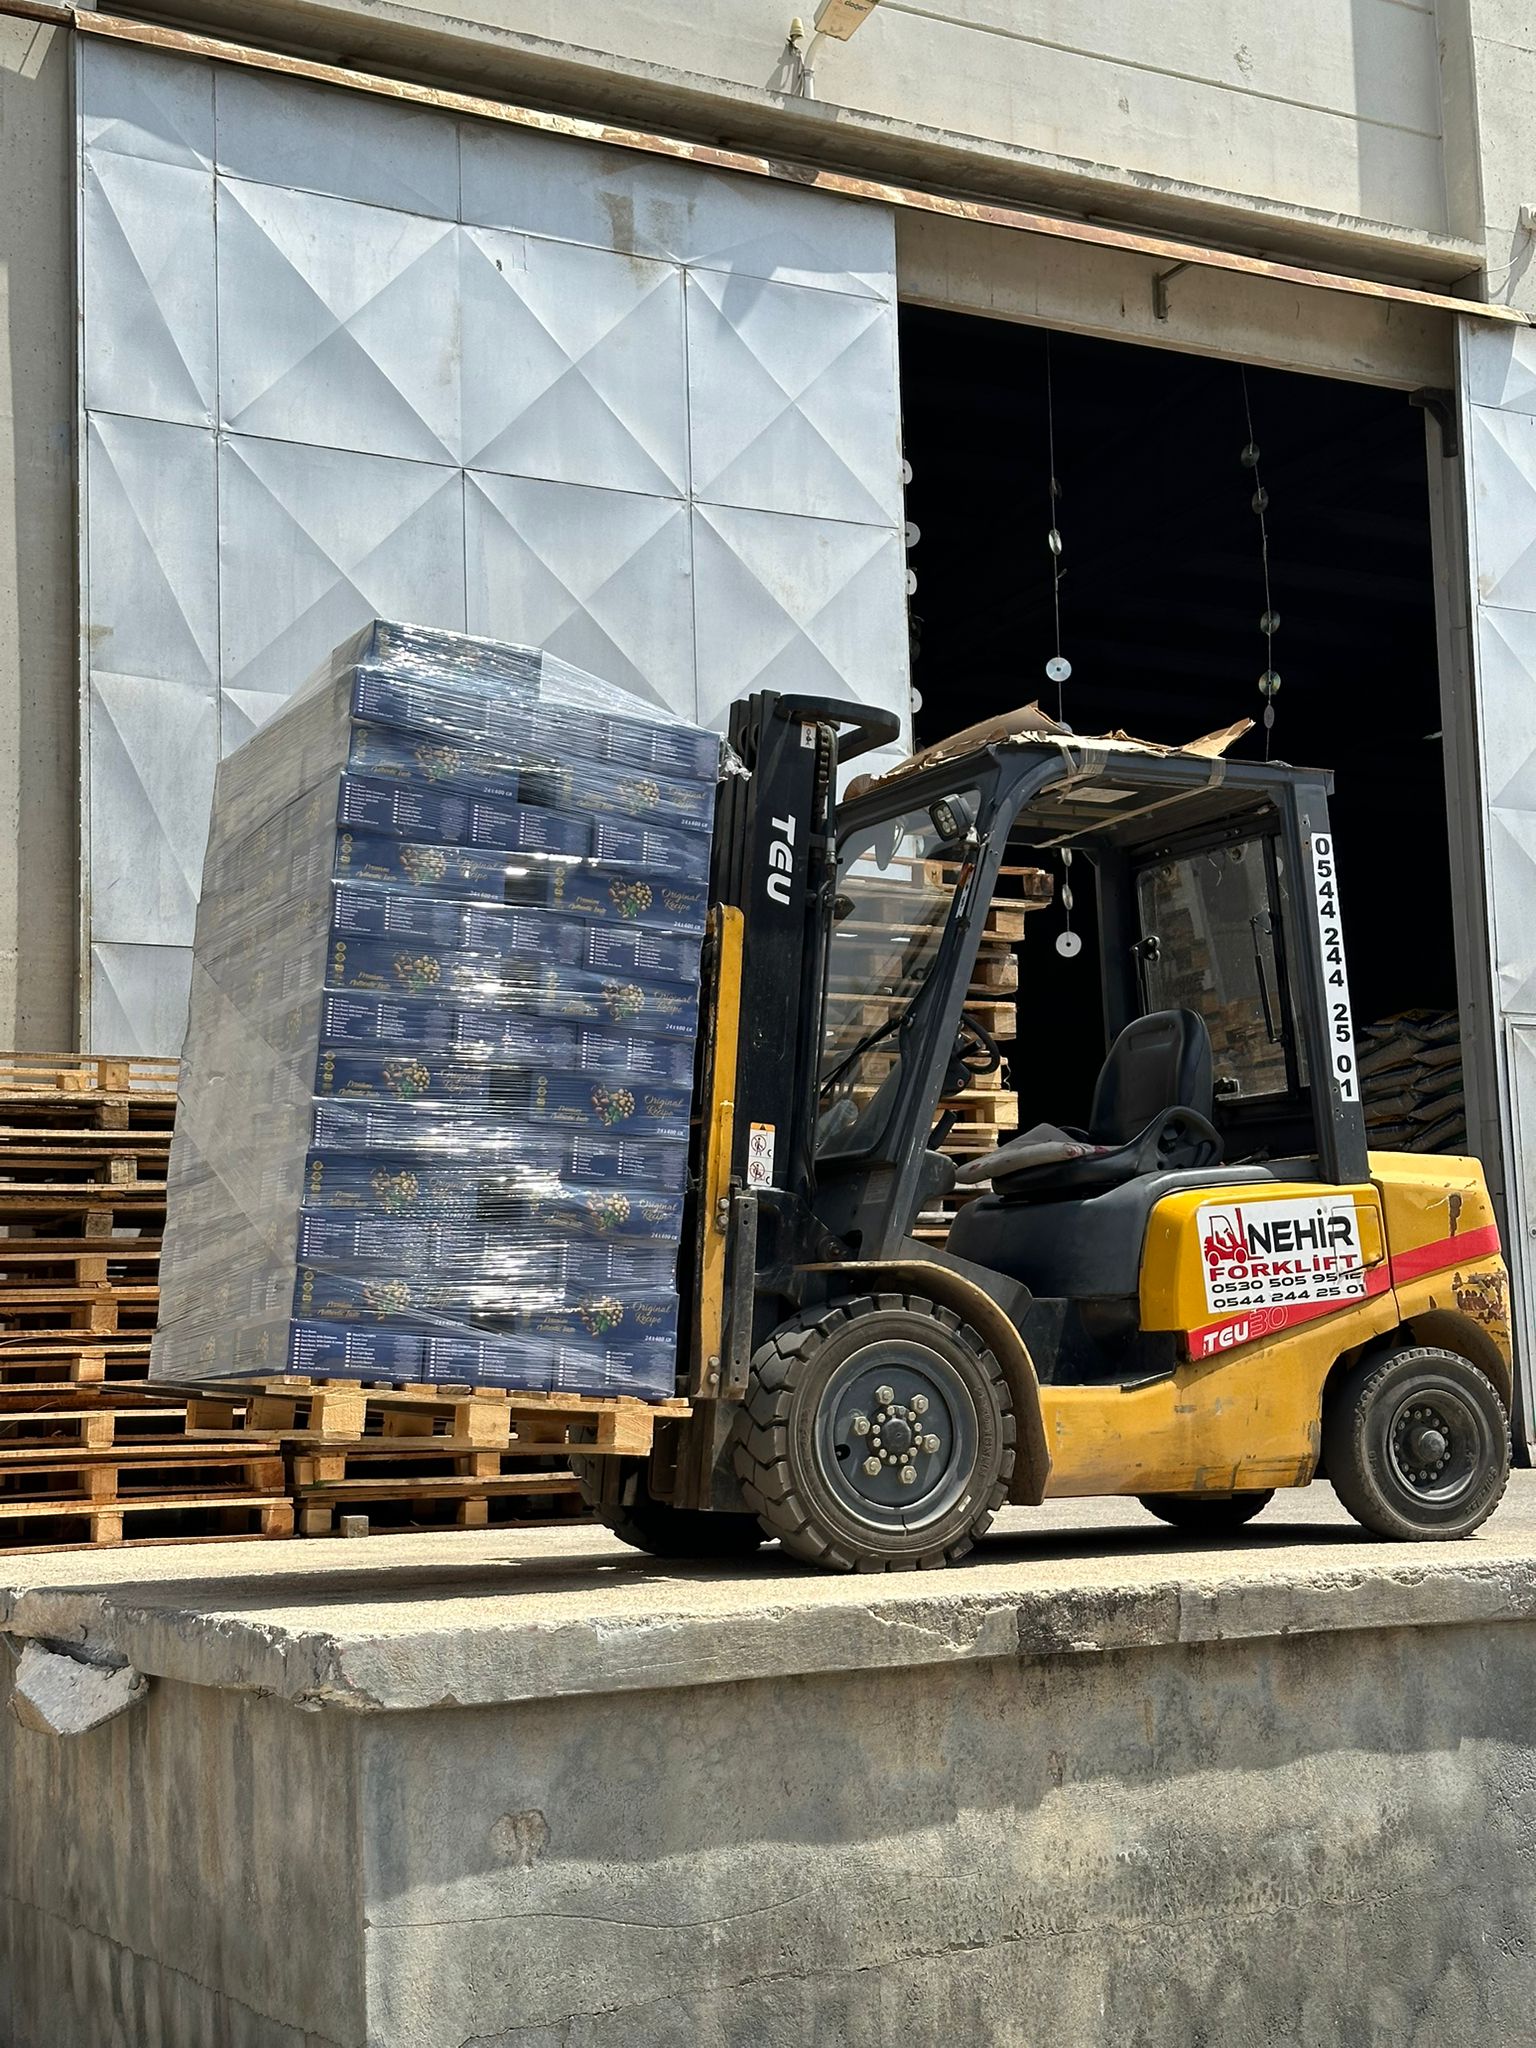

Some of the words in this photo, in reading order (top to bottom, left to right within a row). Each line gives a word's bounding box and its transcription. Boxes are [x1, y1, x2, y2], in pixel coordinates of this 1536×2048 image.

[766, 814, 796, 905] TEU
[1315, 837, 1335, 919] 0544
[1324, 927, 1344, 987] 244
[1333, 1003, 1351, 1043] 25
[1337, 1055, 1352, 1097] 01
[1212, 1280, 1263, 1294] 0530
[1269, 1275, 1307, 1288] 505
[1312, 1272, 1338, 1283] 95
[1213, 1294, 1266, 1308] 0544
[1271, 1290, 1310, 1303] 244
[1316, 1286, 1341, 1297] 25
[1346, 1284, 1365, 1294] 01
